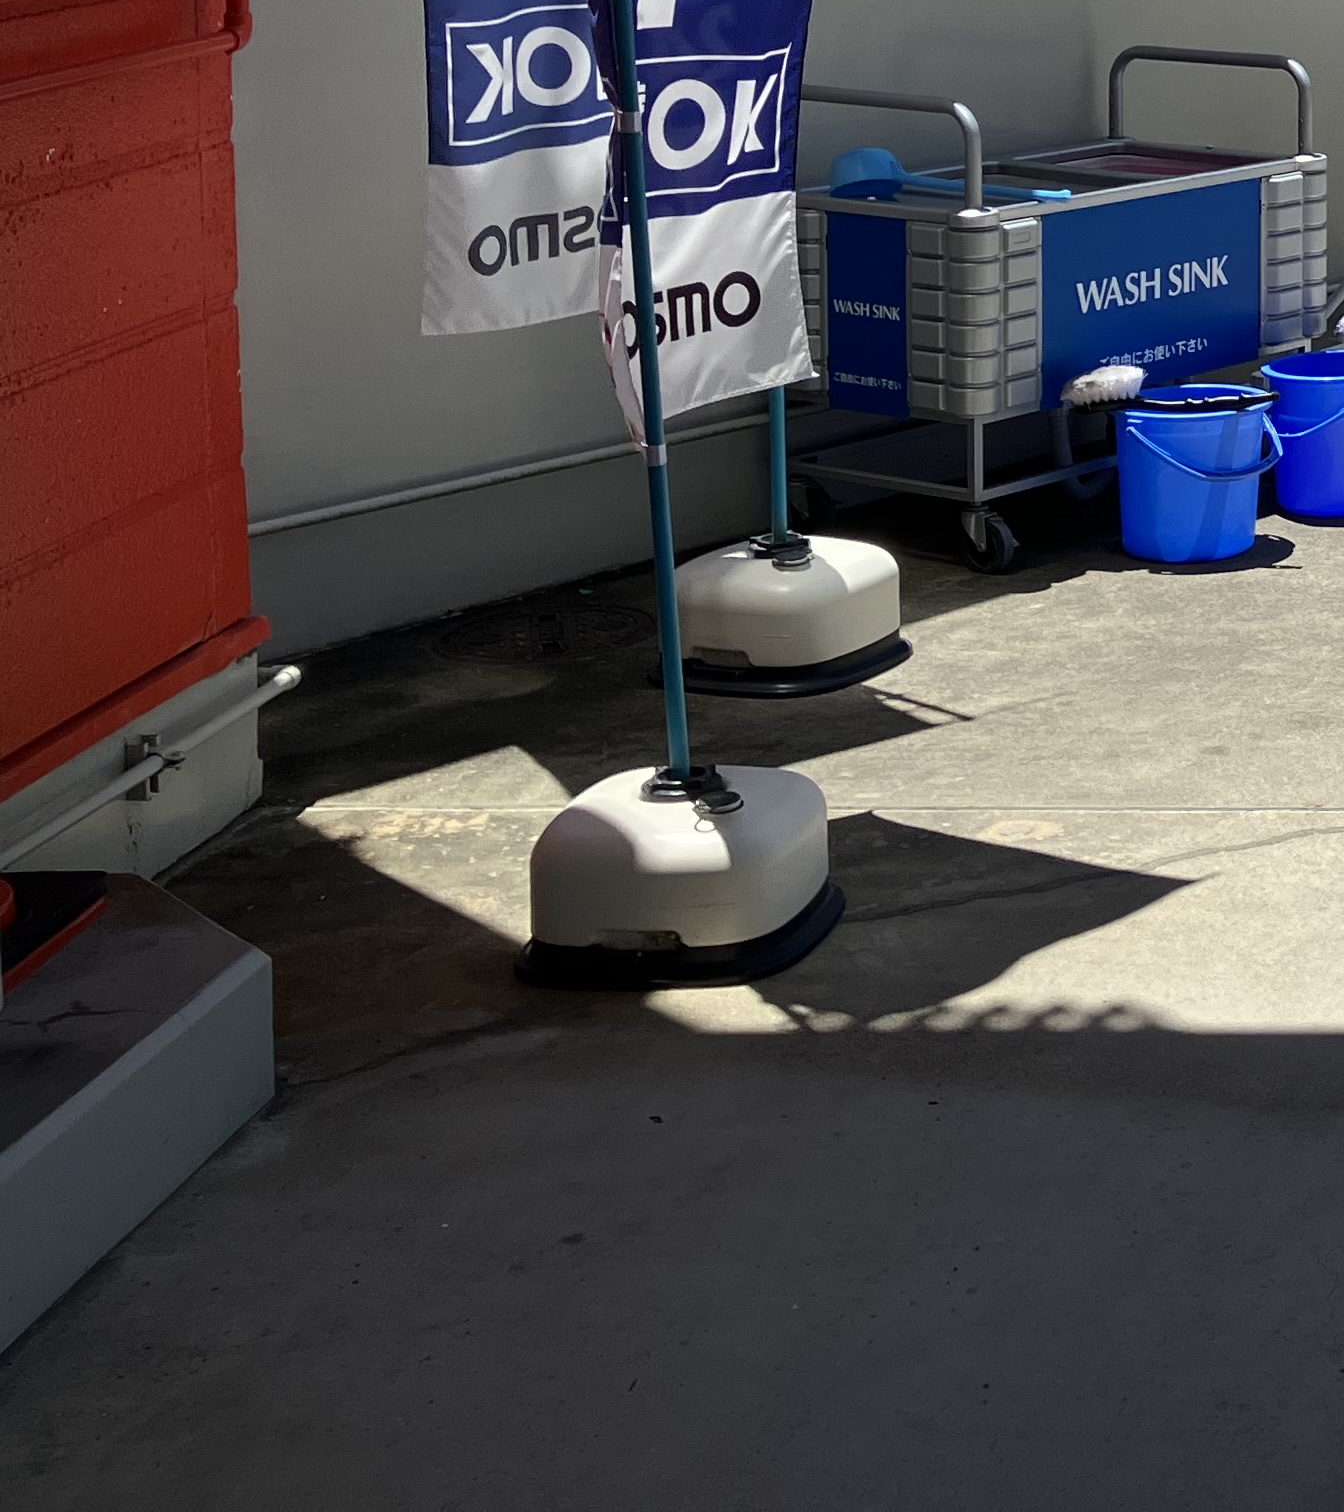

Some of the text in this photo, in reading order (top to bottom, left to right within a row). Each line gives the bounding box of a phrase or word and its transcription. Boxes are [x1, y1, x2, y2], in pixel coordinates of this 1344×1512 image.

[648, 73, 779, 171] OK
[833, 299, 901, 321] WASH SINK
[1076, 255, 1229, 314] WASH SINK
